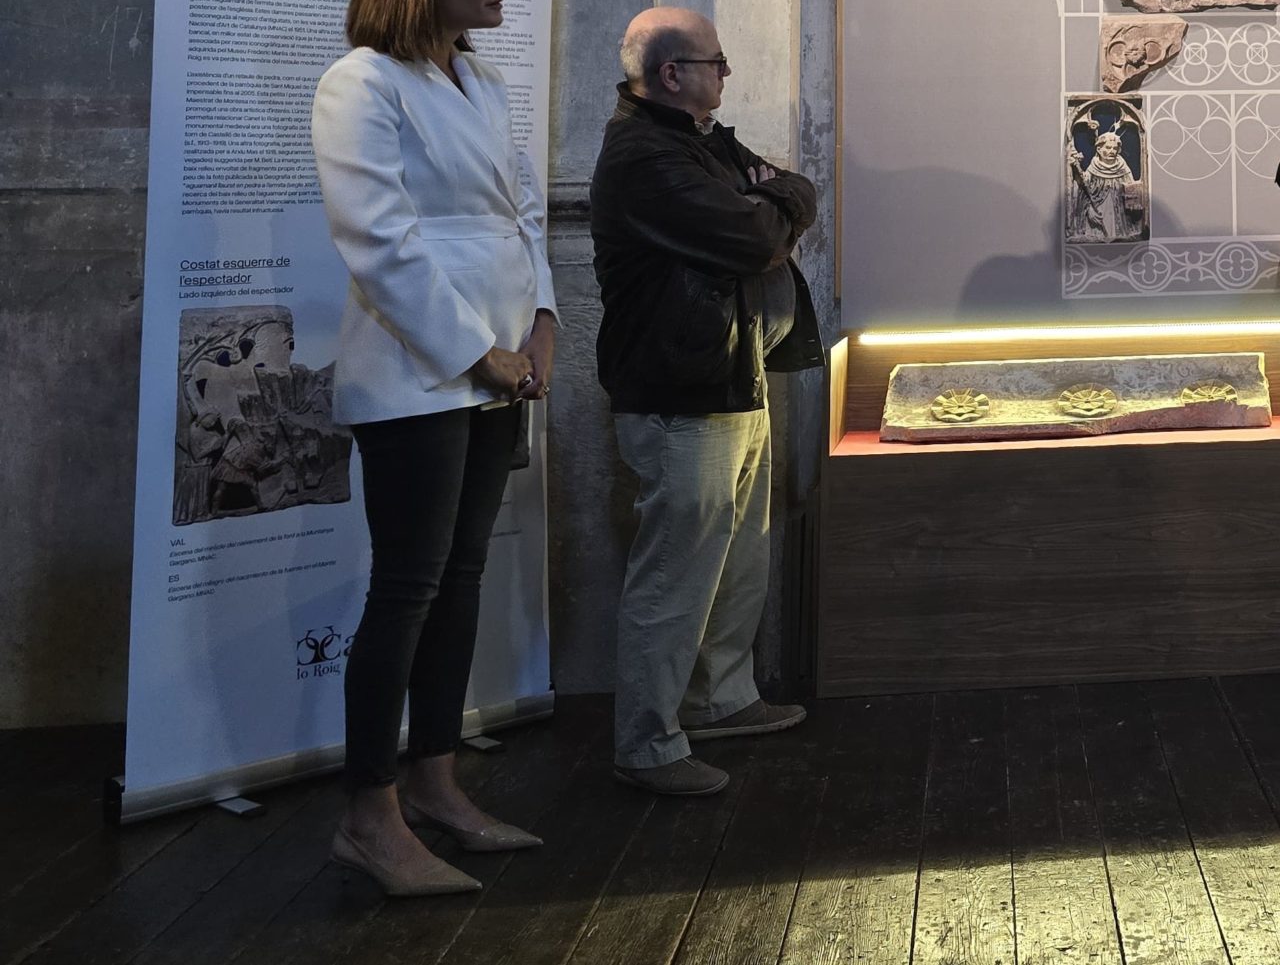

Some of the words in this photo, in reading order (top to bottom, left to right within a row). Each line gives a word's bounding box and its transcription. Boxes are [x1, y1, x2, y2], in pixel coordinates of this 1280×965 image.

[180, 259, 220, 270] Costat
[223, 258, 274, 269] esquerre
[276, 256, 290, 267] de
[180, 272, 252, 286] l'espectador
[179, 291, 200, 299] Lado
[201, 289, 237, 298] izquierdo
[238, 288, 250, 296] del
[251, 286, 294, 295] espectador
[170, 538, 186, 547] VAL
[168, 574, 180, 582] ES
[297, 667, 309, 680] lo
[314, 662, 341, 677] Roig
